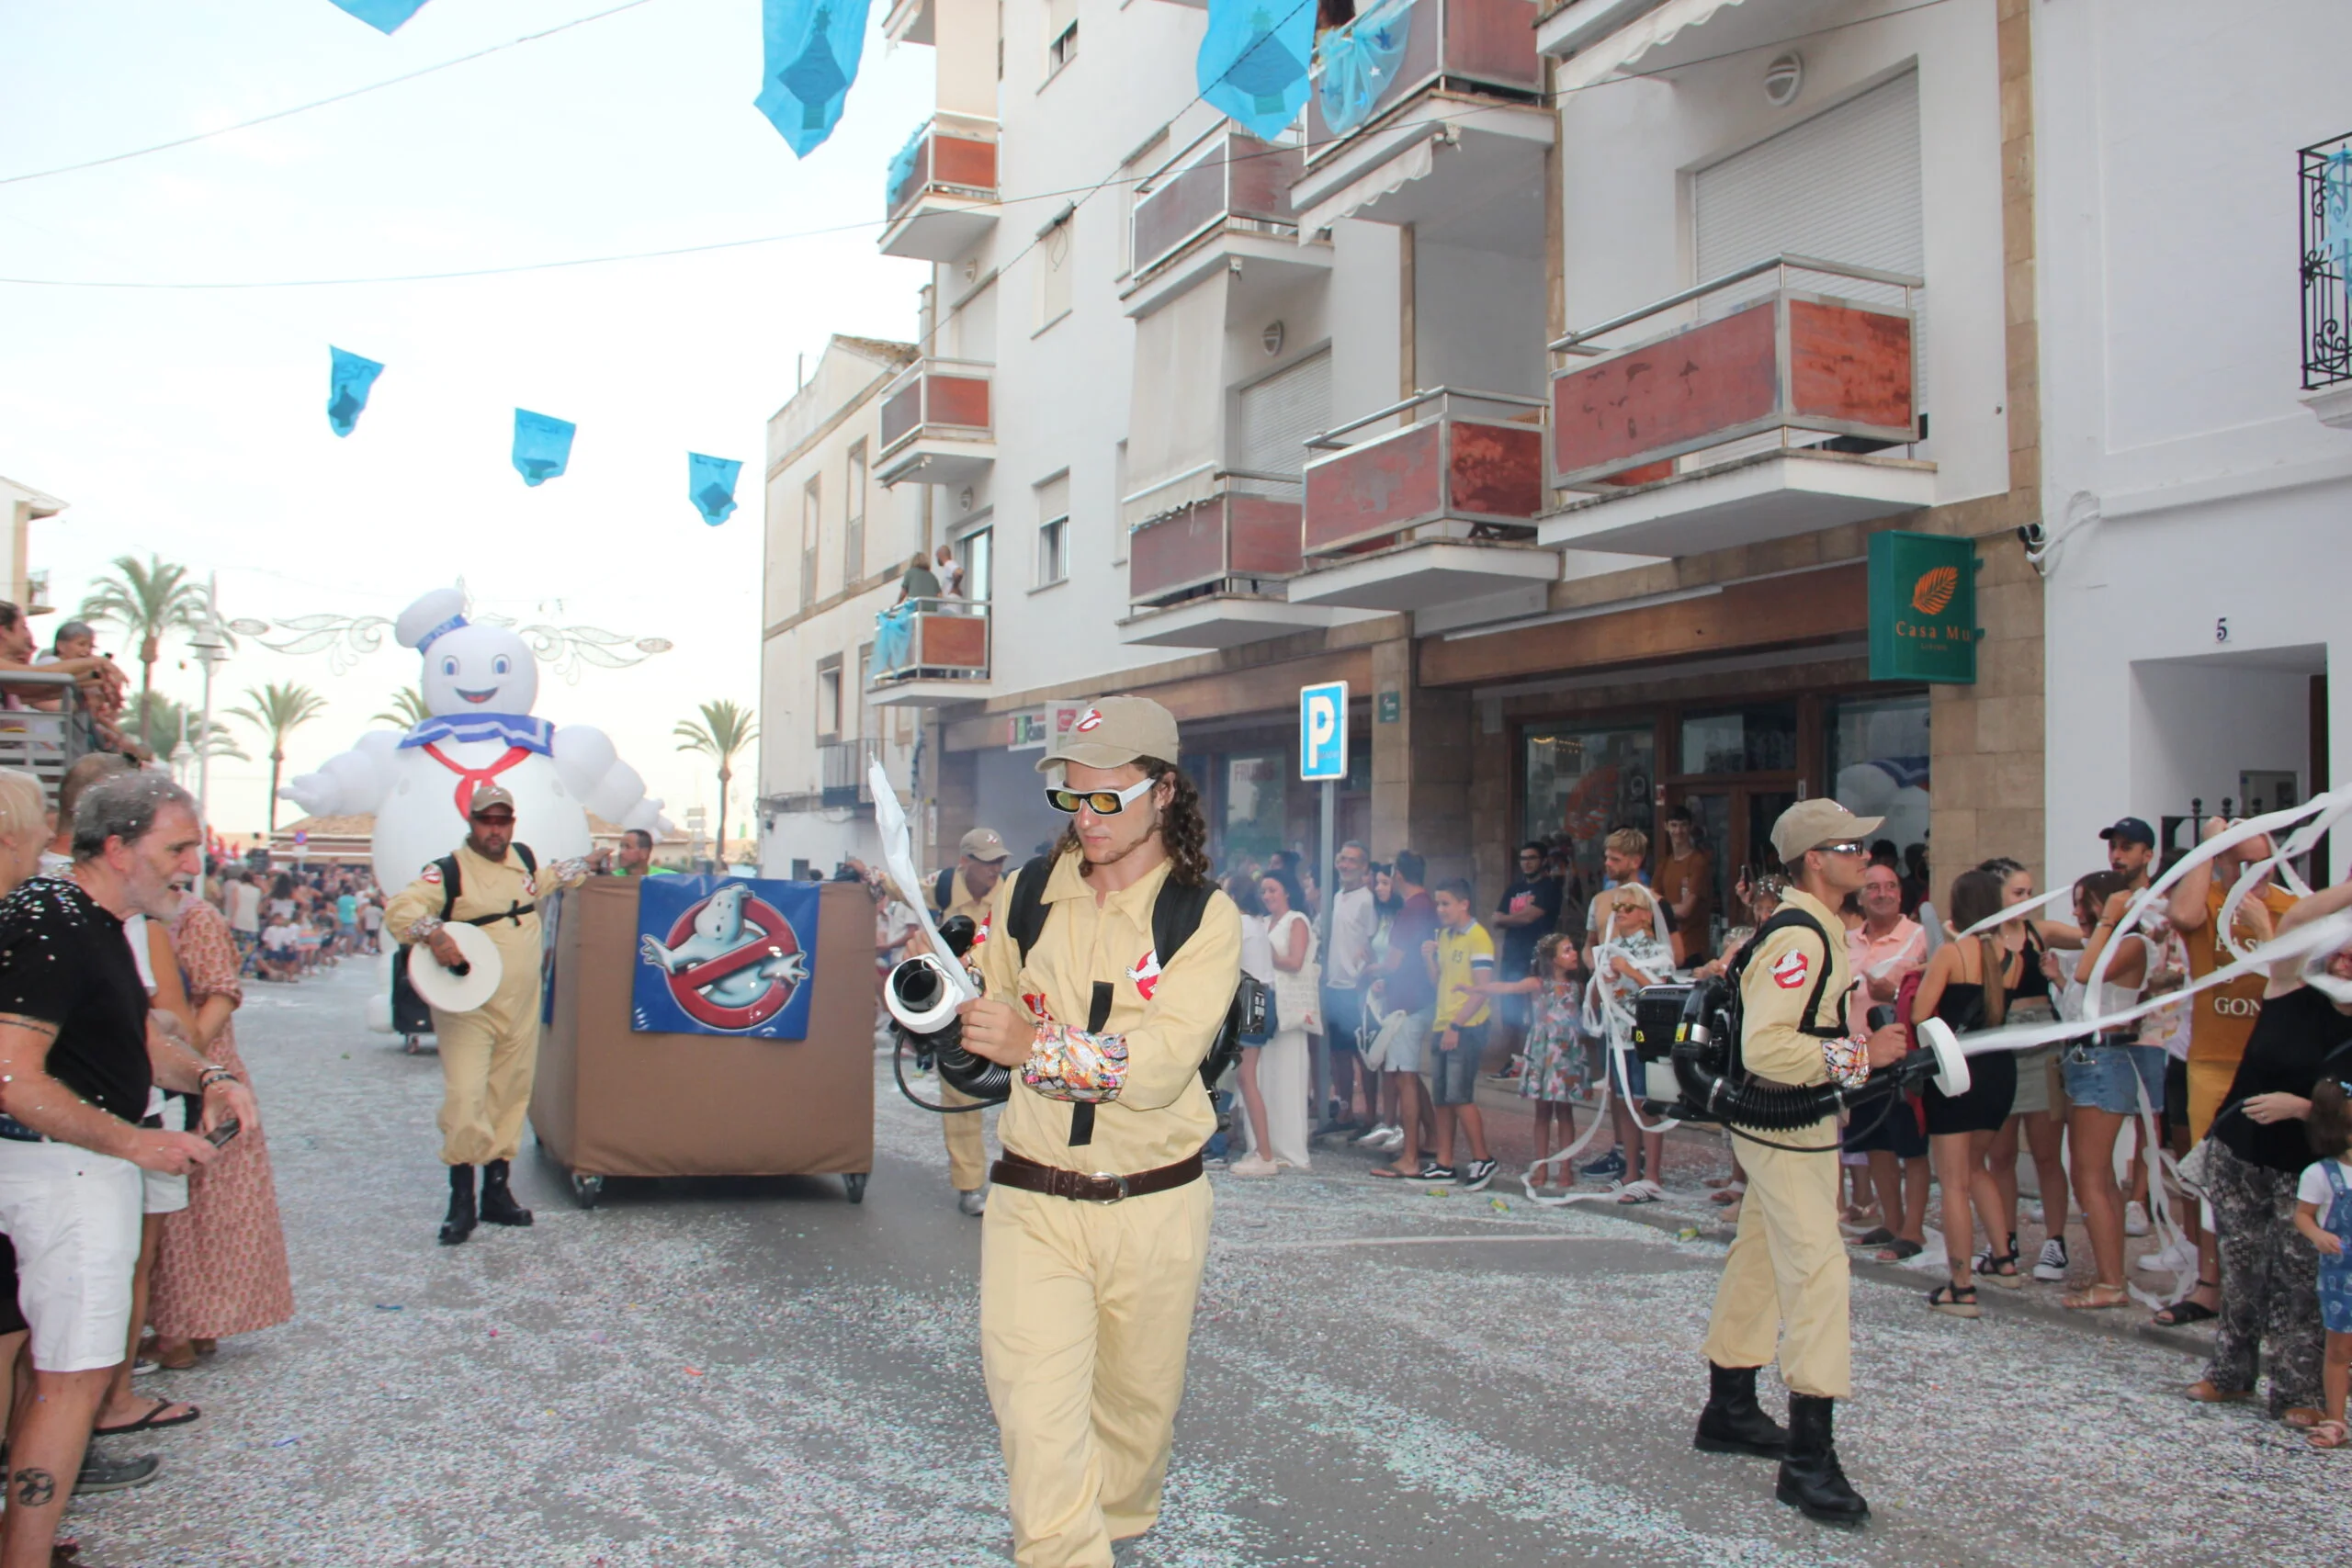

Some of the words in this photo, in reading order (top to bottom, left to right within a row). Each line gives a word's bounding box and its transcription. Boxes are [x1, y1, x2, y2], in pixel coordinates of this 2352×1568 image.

[1895, 620, 1937, 639] Casa
[2216, 616, 2228, 641] 5
[1308, 695, 1334, 769] P
